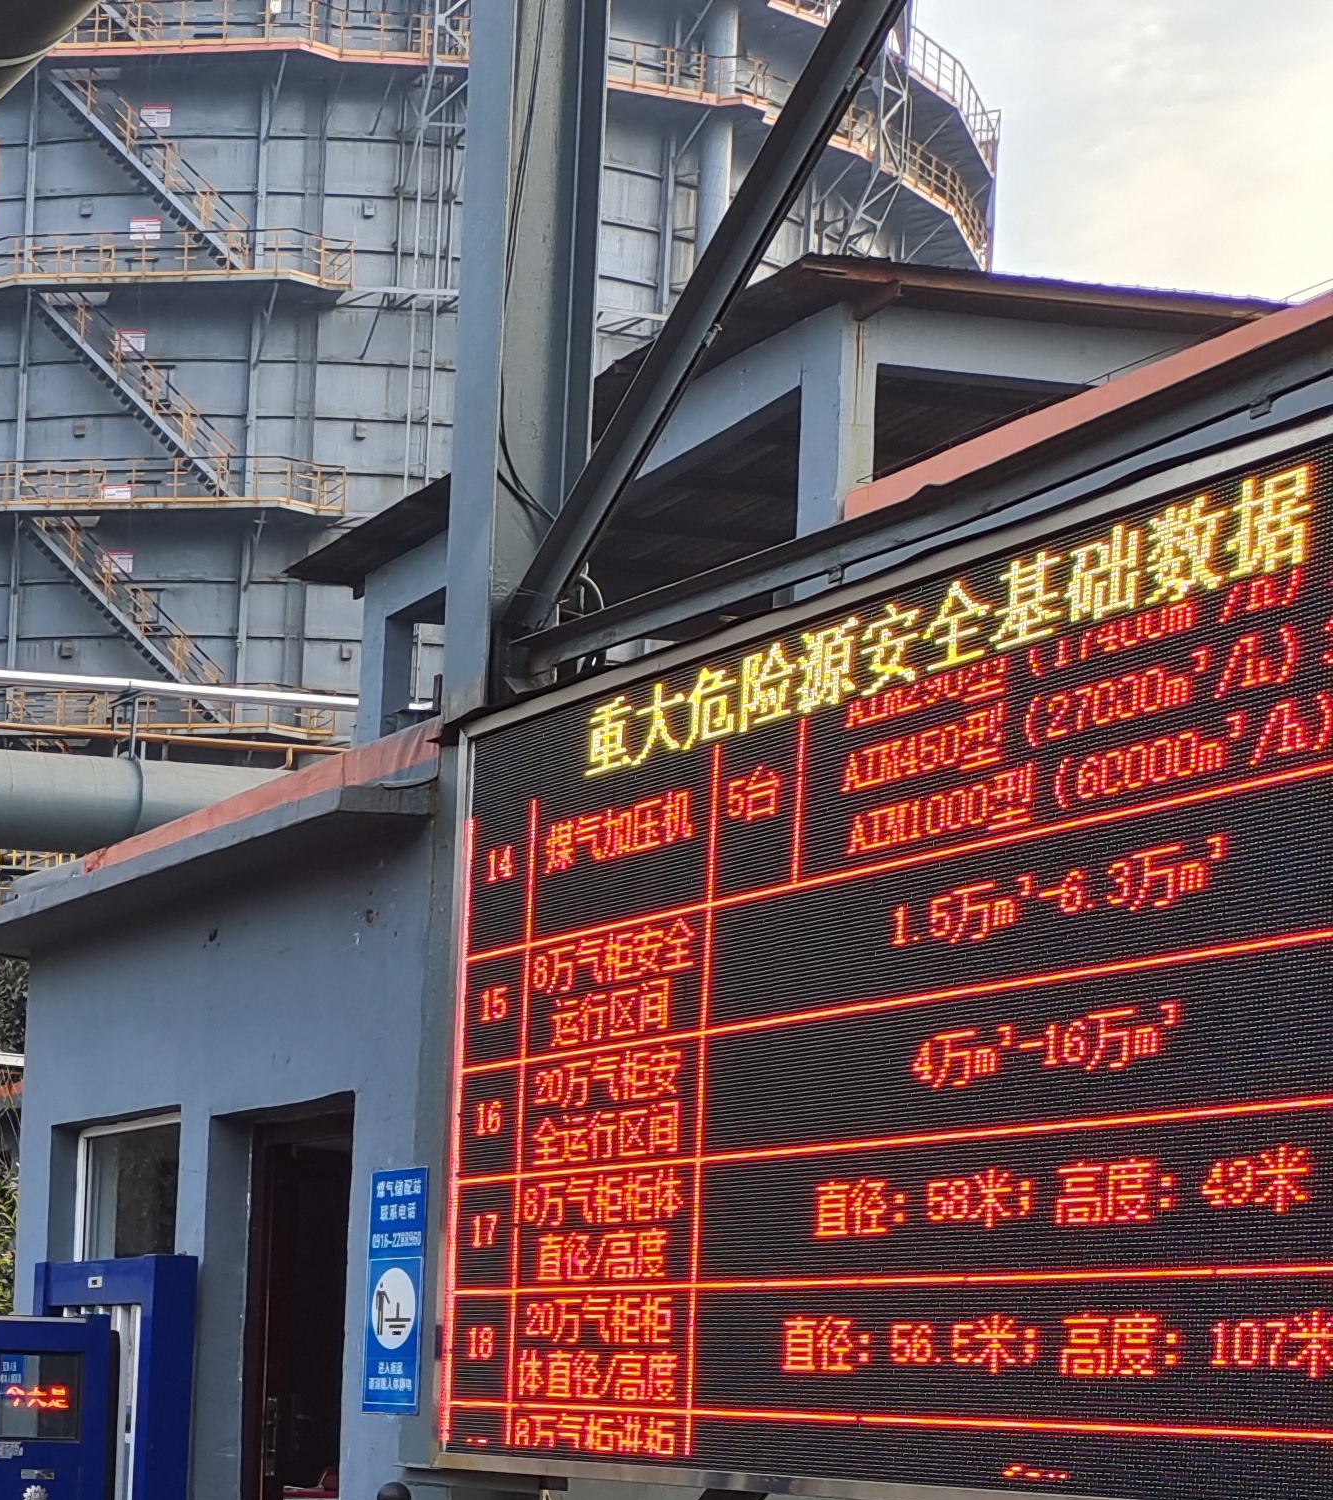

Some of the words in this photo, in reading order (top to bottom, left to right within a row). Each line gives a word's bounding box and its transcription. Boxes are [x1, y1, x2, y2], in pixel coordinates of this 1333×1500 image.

[585, 464, 1311, 776] 重大危险源安全基础数据
[727, 765, 781, 822] 5台
[544, 791, 695, 874] 煤气加压机
[487, 846, 514, 883] 14
[533, 917, 695, 994] 8万气柜安全
[481, 986, 509, 1021] 15
[551, 978, 671, 1047] 运行区间
[533, 1045, 681, 1108] 20万气柜安
[476, 1100, 503, 1136] 16
[532, 1100, 679, 1166] 全运行区间
[523, 1167, 683, 1227] 8万气柜柜体
[472, 1213, 499, 1248] 17
[536, 1227, 667, 1281] 直径/高度
[468, 1326, 494, 1359] 18
[525, 1293, 672, 1343] 20万气柜柜
[517, 1349, 678, 1401] 体直径/高度
